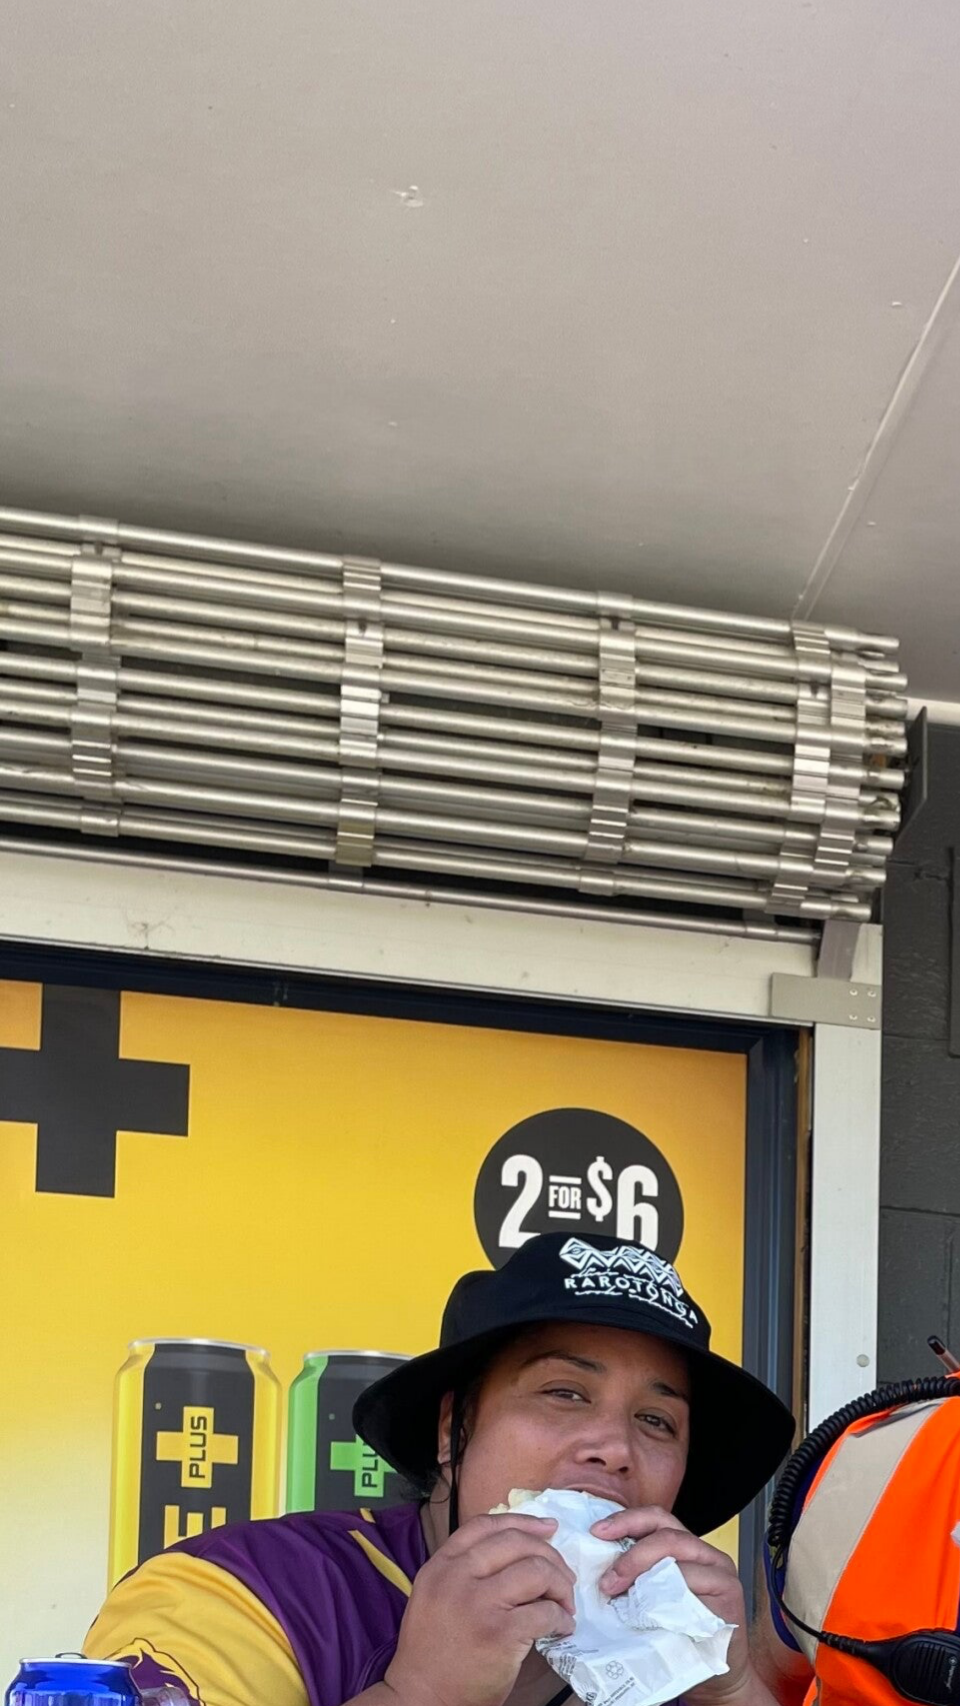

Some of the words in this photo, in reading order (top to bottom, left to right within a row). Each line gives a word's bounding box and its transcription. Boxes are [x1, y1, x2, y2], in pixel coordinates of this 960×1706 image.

[498, 1154, 543, 1249] 2
[548, 1185, 582, 1210] FOR
[586, 1156, 659, 1252] $6
[563, 1274, 699, 1324] RAROTONGA
[188, 1415, 208, 1479] PLUS
[361, 1442, 379, 1488] PLU
